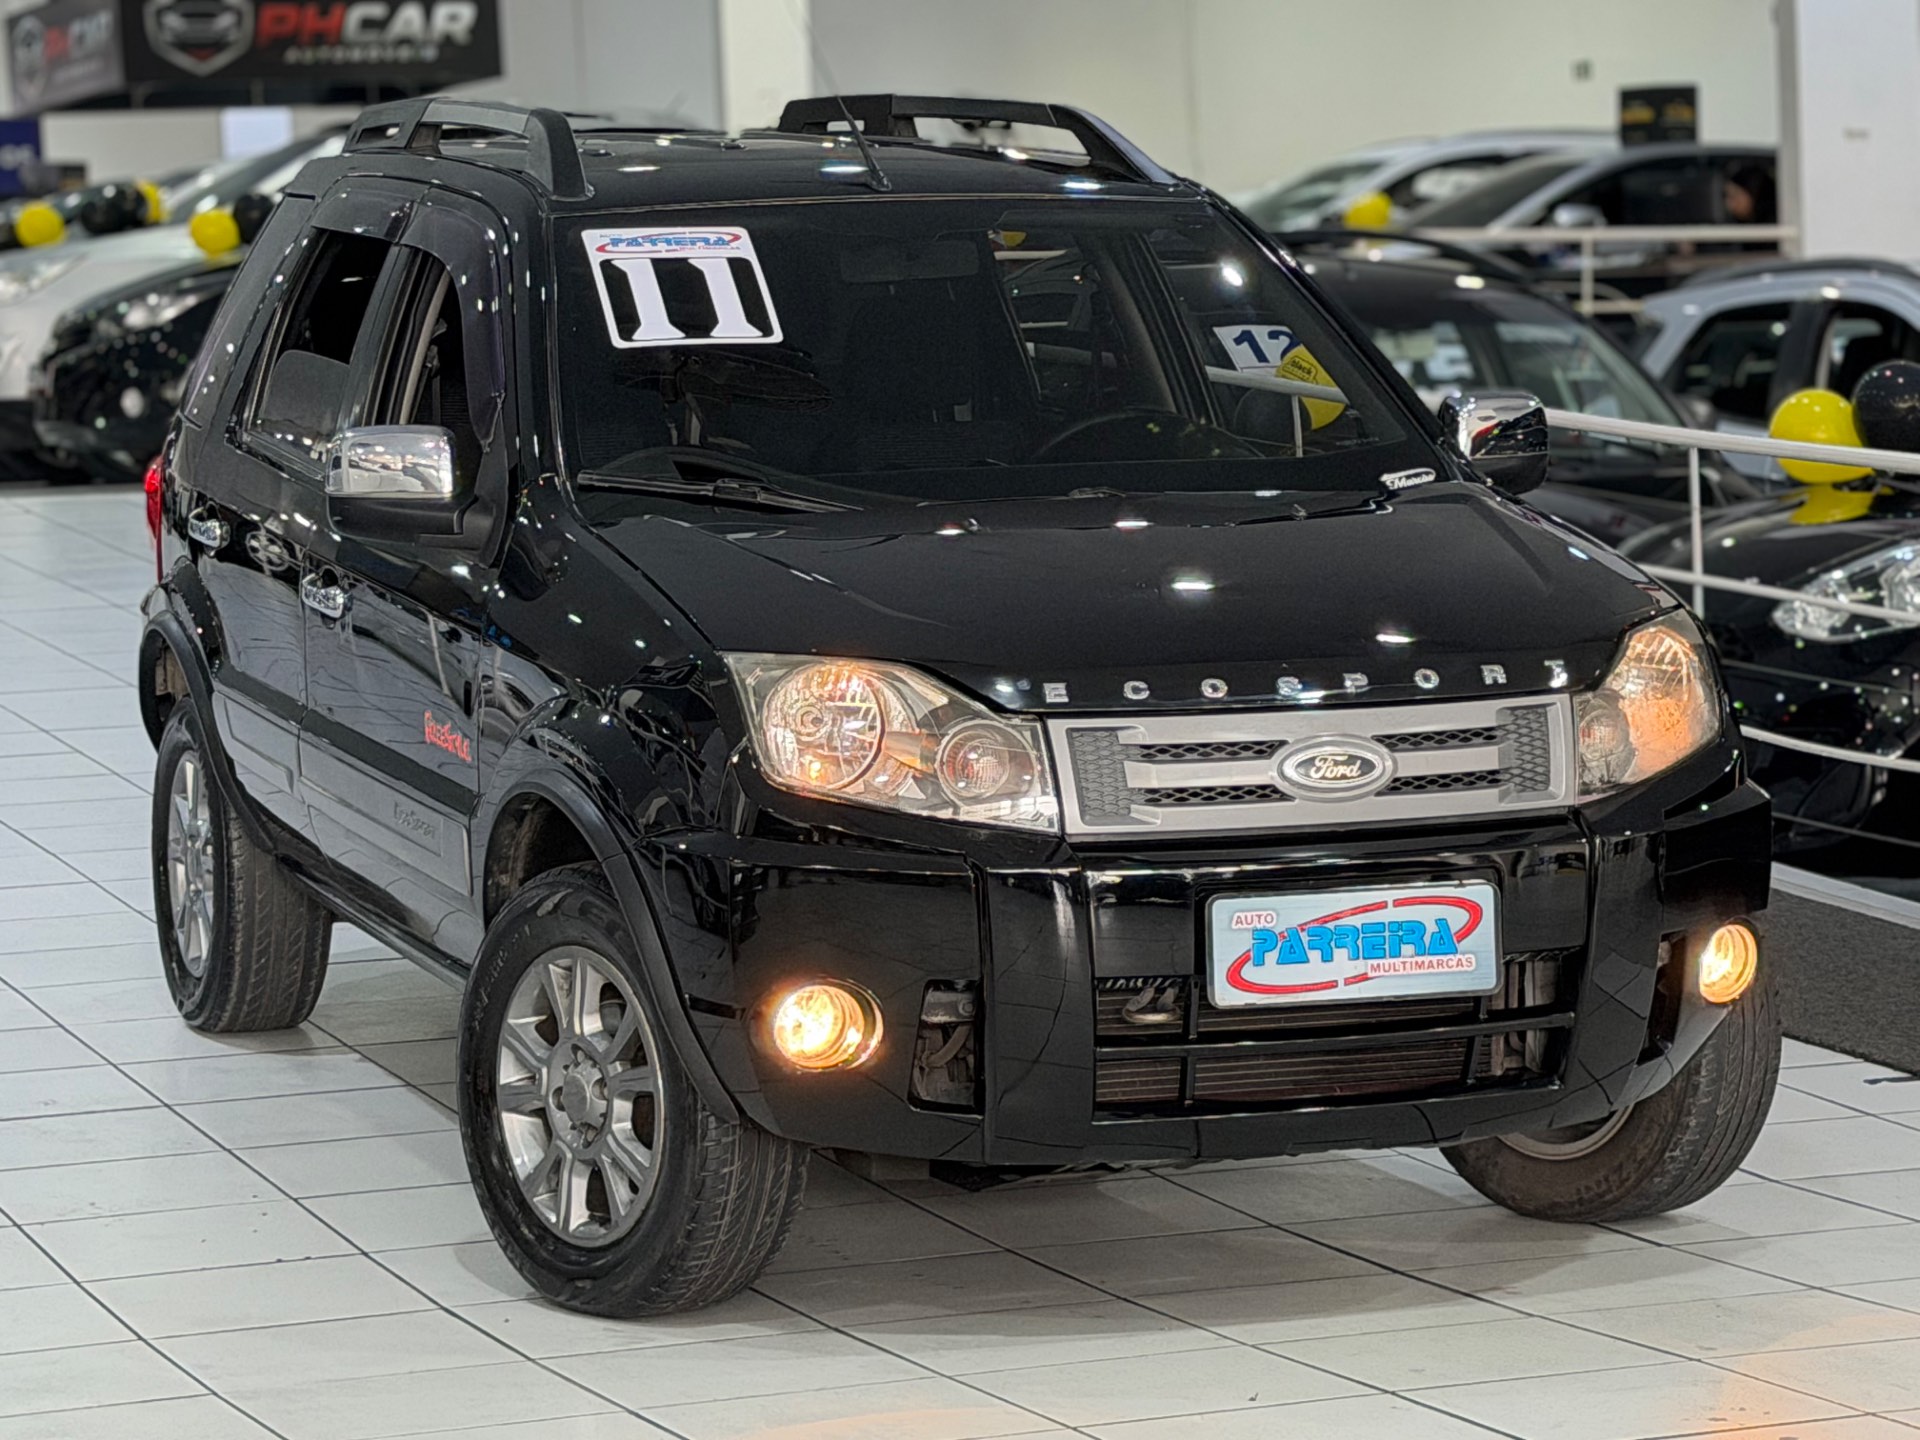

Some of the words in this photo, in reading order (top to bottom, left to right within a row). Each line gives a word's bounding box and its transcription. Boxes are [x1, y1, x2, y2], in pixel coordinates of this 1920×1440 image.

[254, 1, 479, 47] PHCAR
[611, 257, 764, 341] 11
[1042, 659, 1569, 704] ECOSPORT
[1310, 755, 1363, 779] Ford
[1233, 912, 1276, 927] AUTO
[1252, 917, 1459, 967] PARREIRA
[1369, 955, 1475, 975] MULTIMARCAS
